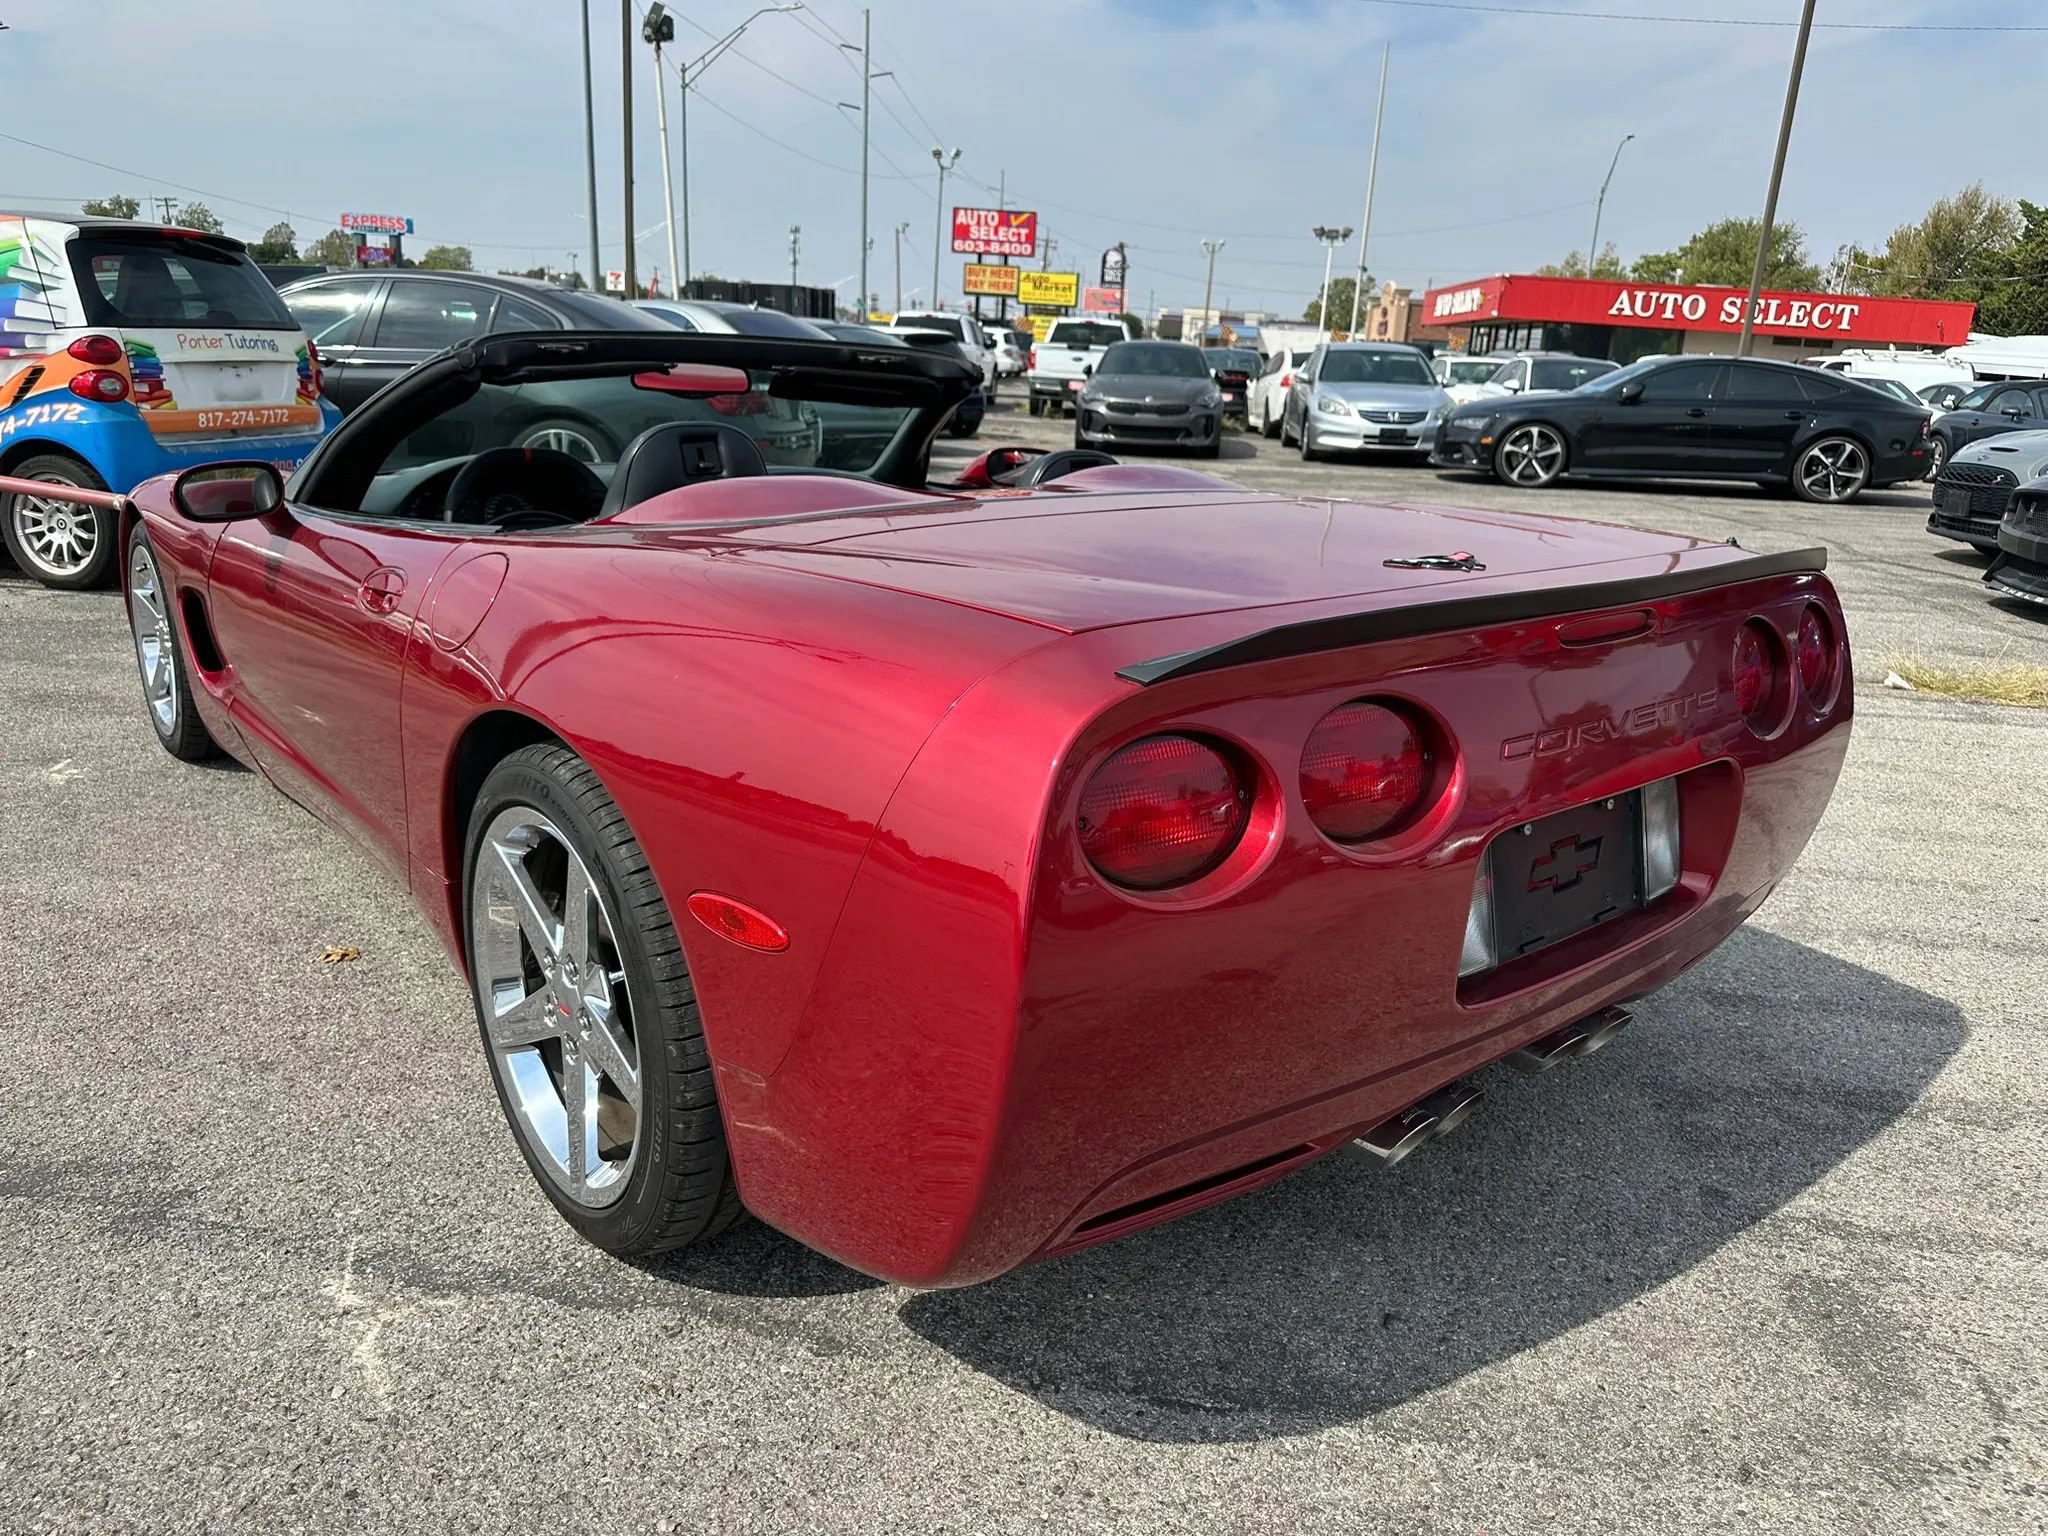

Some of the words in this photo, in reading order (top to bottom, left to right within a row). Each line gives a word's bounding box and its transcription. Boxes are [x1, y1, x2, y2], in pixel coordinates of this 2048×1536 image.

[341, 212, 405, 231] EXPRESS
[956, 208, 1000, 226] AUTO
[968, 226, 1029, 242] SELECT
[953, 239, 1032, 255] 603-8400
[967, 267, 987, 277] BUY
[990, 269, 1015, 279] HERE
[967, 279, 985, 289] PAY
[988, 281, 1014, 291] HERE
[1608, 289, 1707, 321] AUTO
[176, 333, 223, 350] Porter
[224, 333, 279, 352] Tutoring
[198, 409, 289, 428] 817-274-7172
[1500, 687, 1720, 762] CORVETTE
